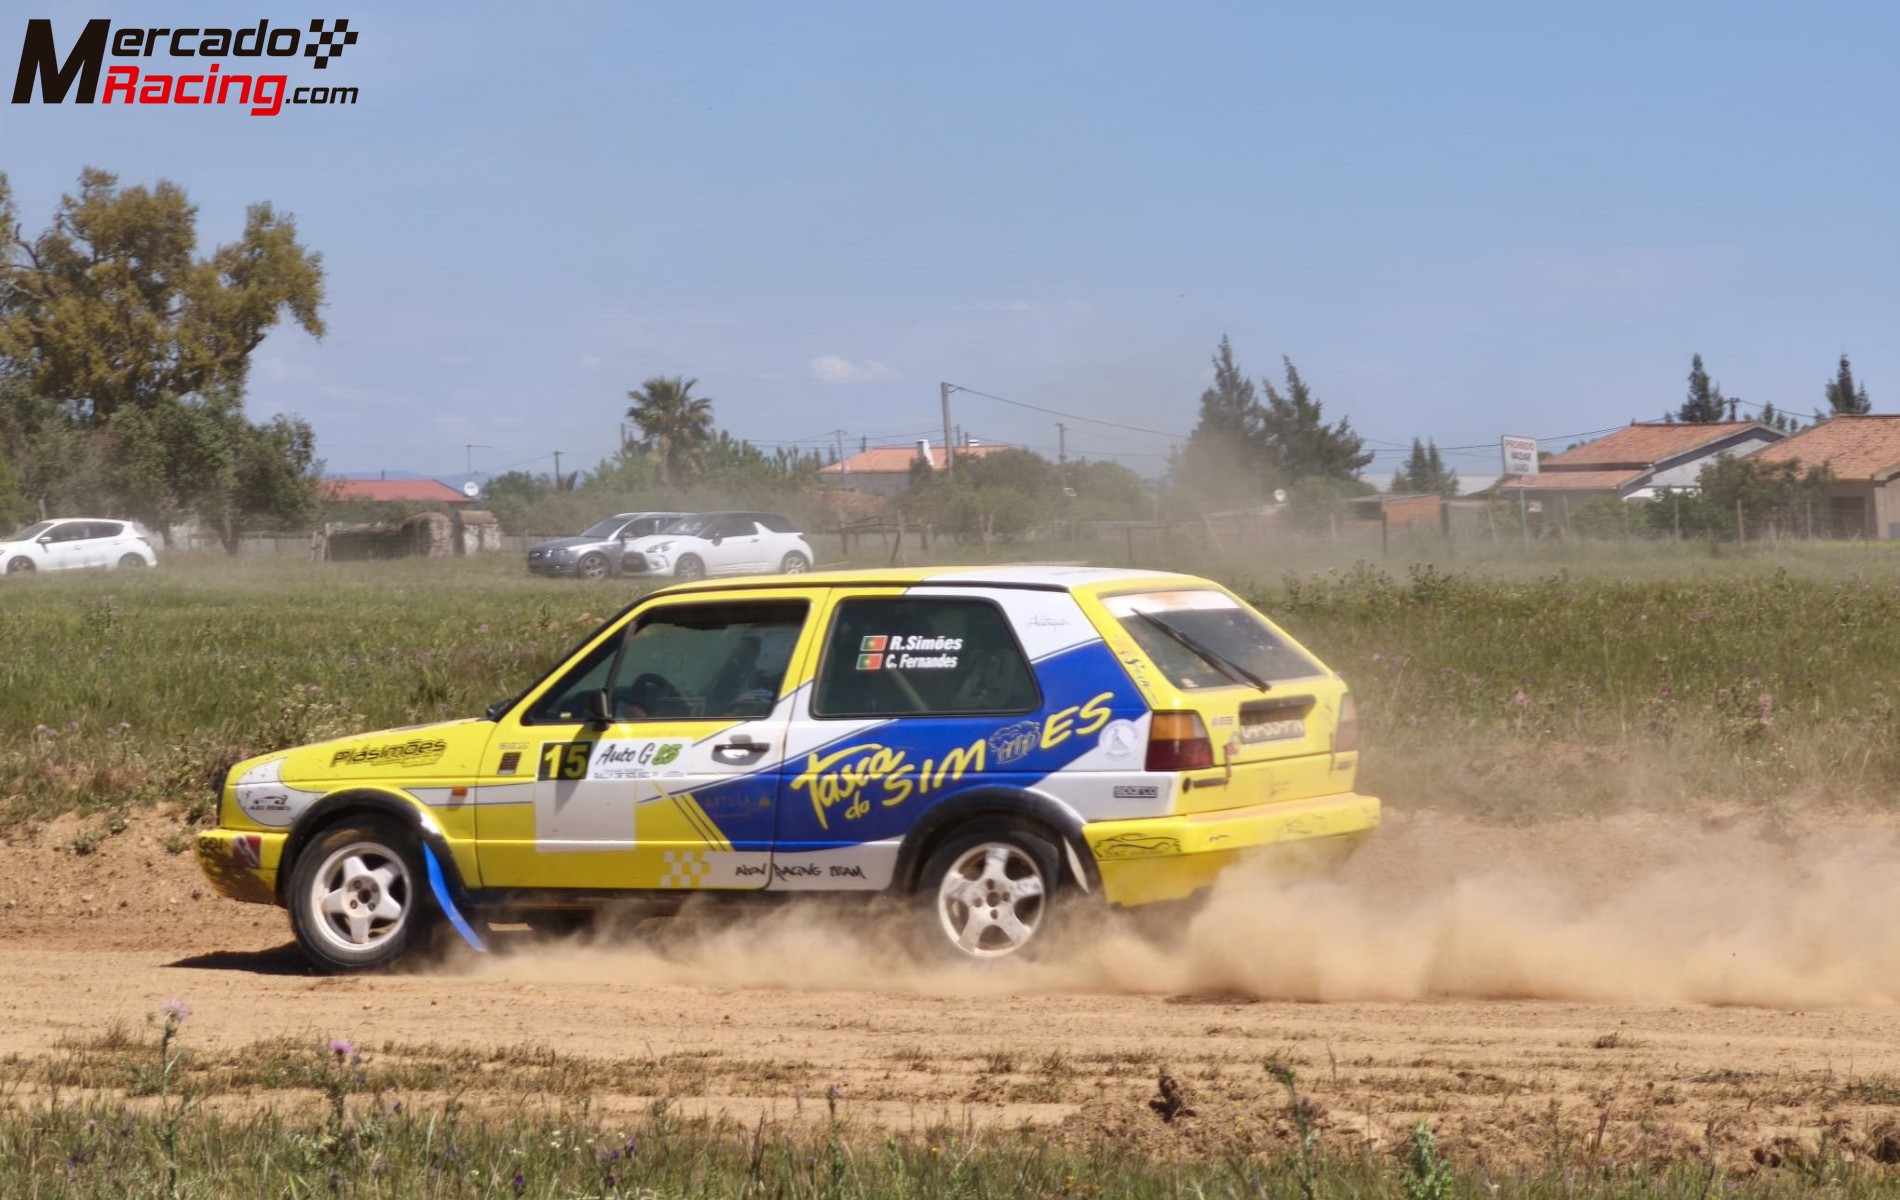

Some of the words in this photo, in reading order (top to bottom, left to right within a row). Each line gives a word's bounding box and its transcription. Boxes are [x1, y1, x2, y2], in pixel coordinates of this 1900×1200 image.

[889, 635, 963, 650] R.Simões
[899, 653, 958, 668] Fernandes
[543, 744, 588, 779] 15
[594, 743, 636, 765] Auto
[790, 744, 904, 830] Tasca
[845, 791, 870, 820] do
